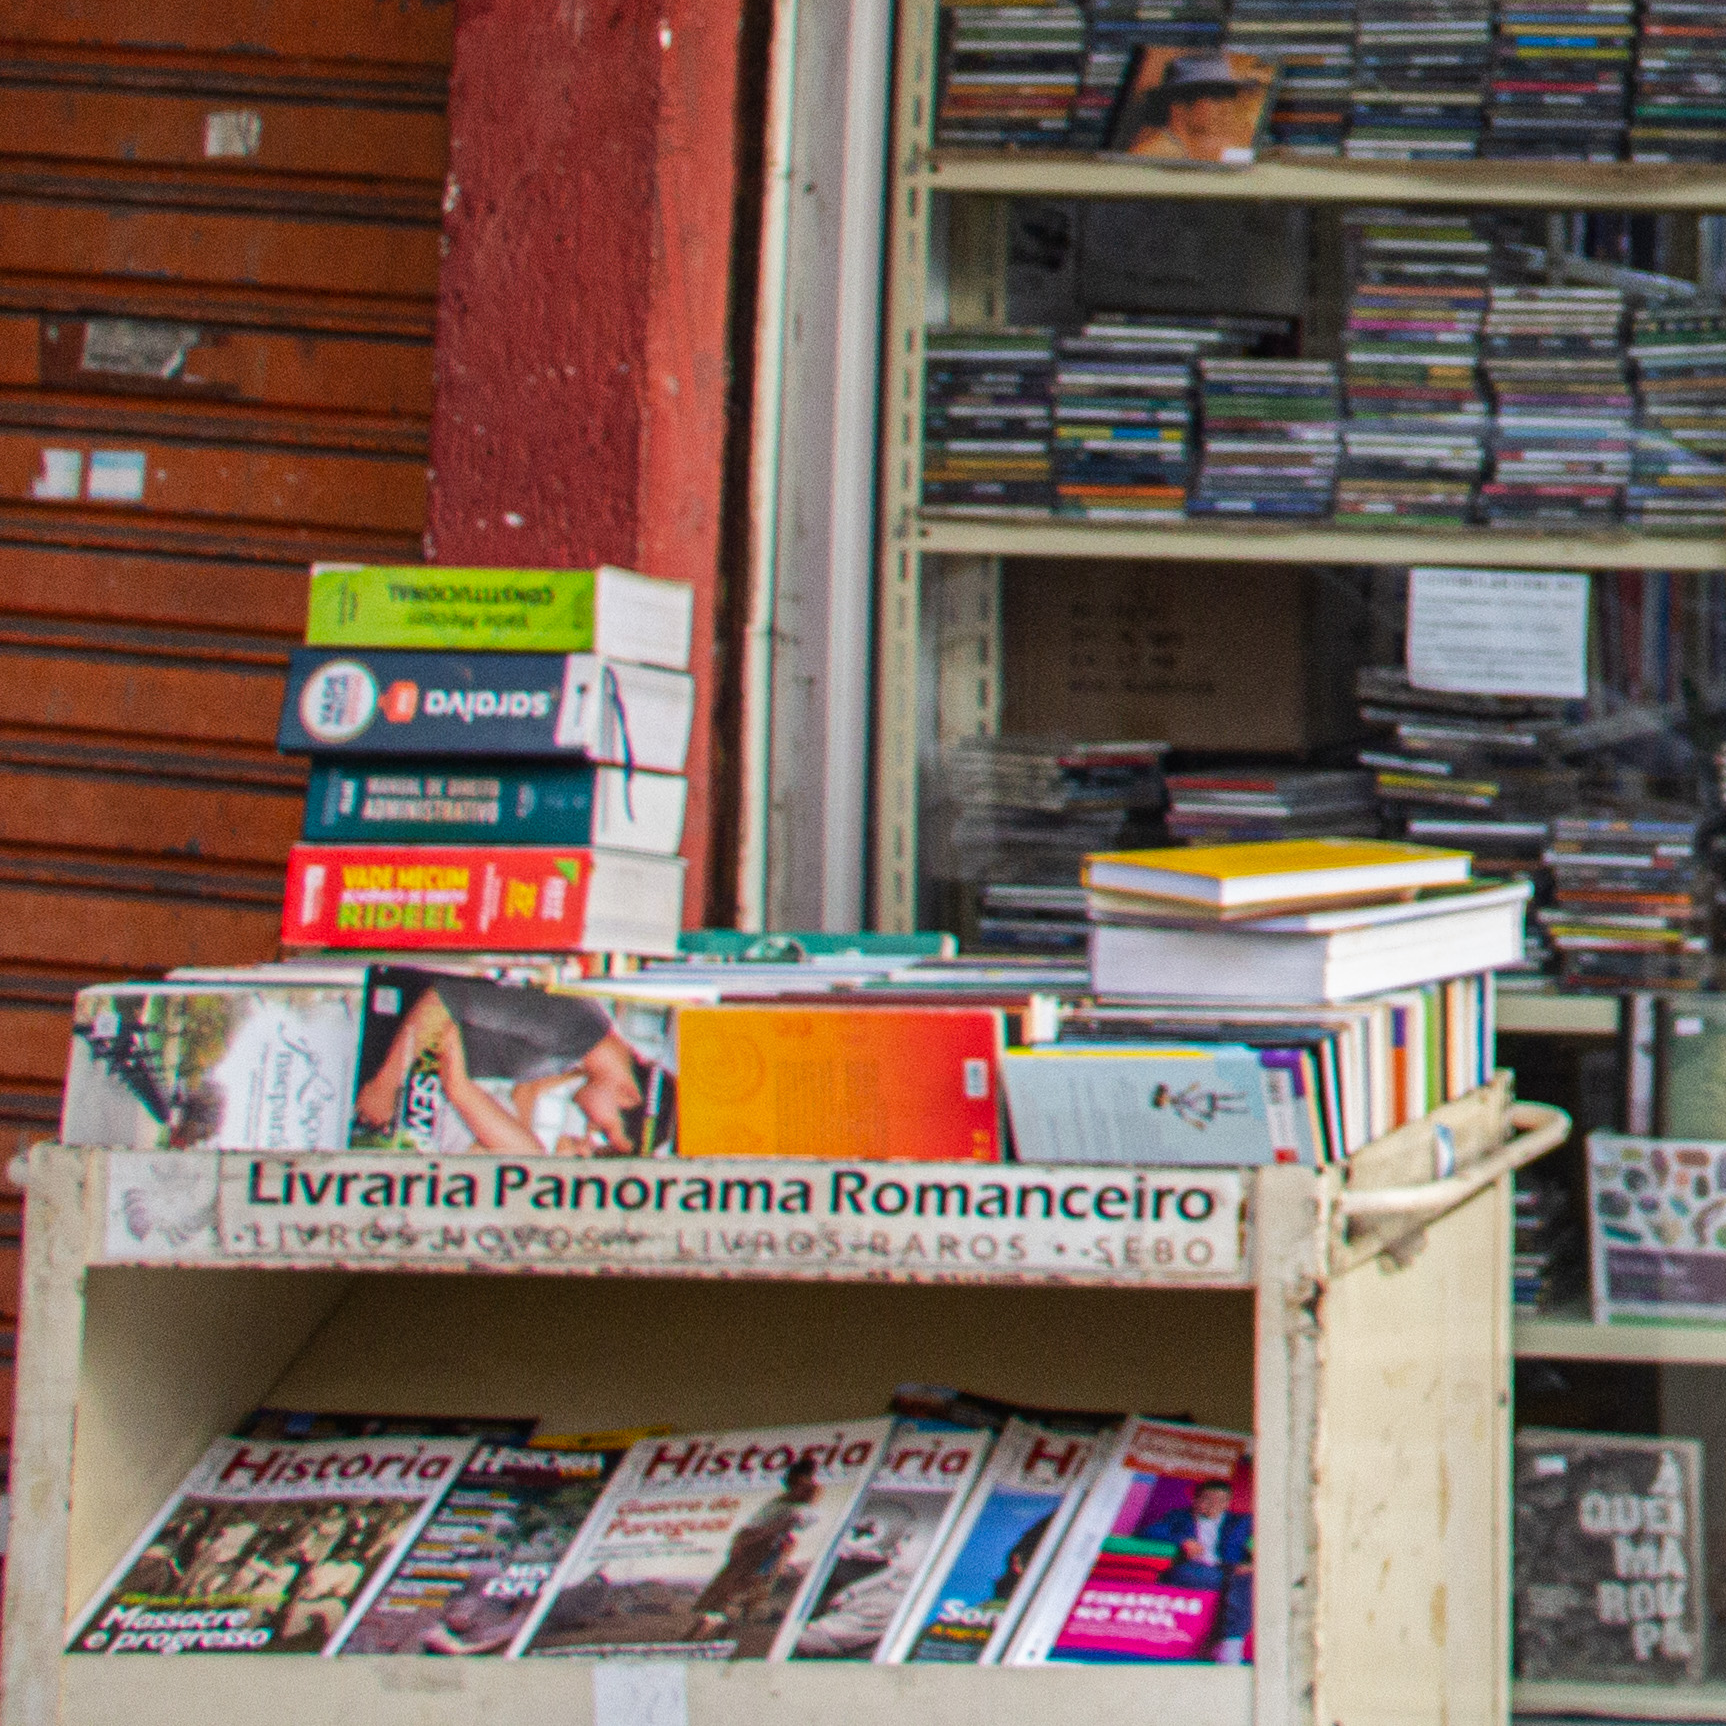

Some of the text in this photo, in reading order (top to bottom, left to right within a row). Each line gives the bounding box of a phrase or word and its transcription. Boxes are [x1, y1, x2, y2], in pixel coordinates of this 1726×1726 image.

[423, 687, 551, 722] saraiva
[336, 902, 463, 931] RIDEEL
[248, 1160, 1217, 1223] Livraria Panorama Romanceiro
[98, 1606, 251, 1631] Massacre
[83, 1627, 273, 1655] e progresso
